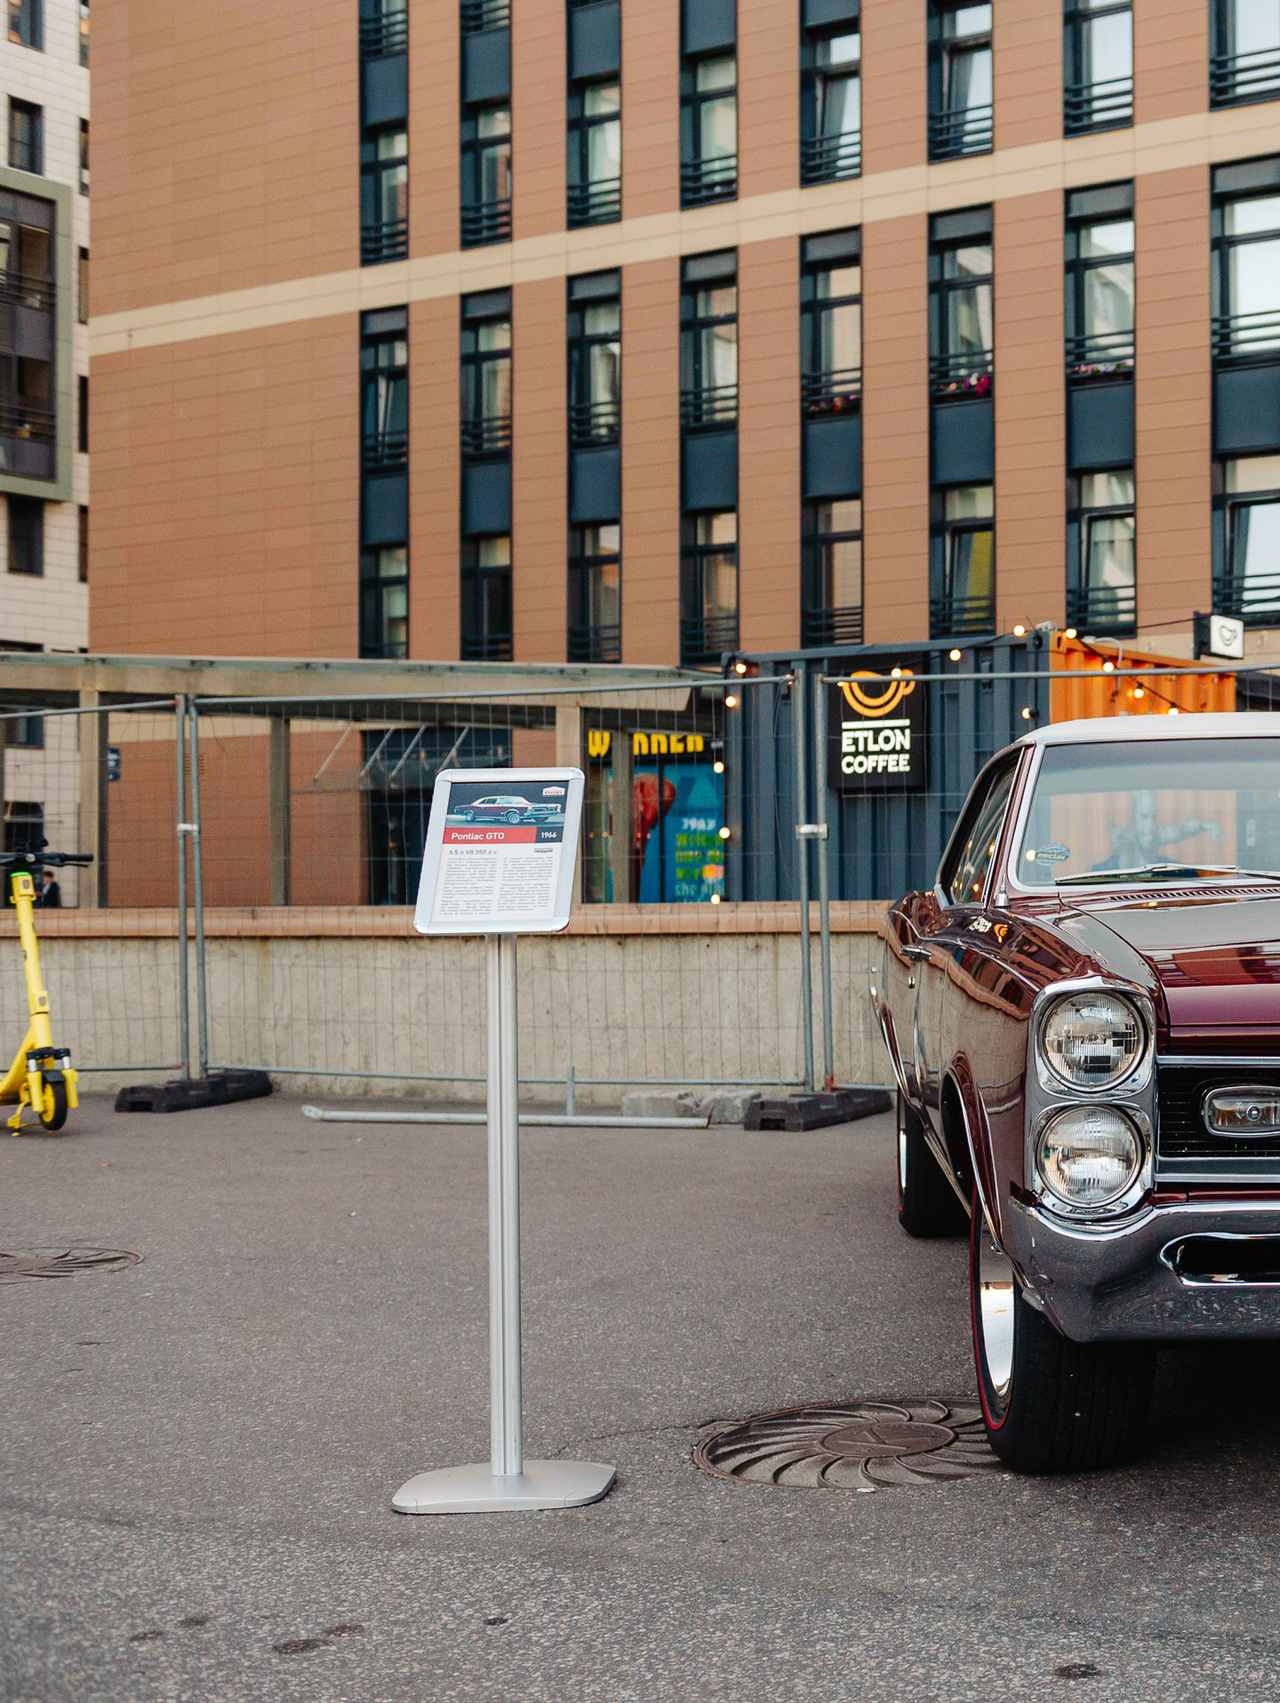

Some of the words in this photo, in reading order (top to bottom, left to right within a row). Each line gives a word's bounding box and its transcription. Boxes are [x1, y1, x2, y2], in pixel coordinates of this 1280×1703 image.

[842, 728, 910, 752] ETLON
[841, 753, 910, 774] COFFEE
[451, 832, 484, 840] Pontiac
[486, 832, 505, 840] GTO
[541, 831, 557, 839] 1966
